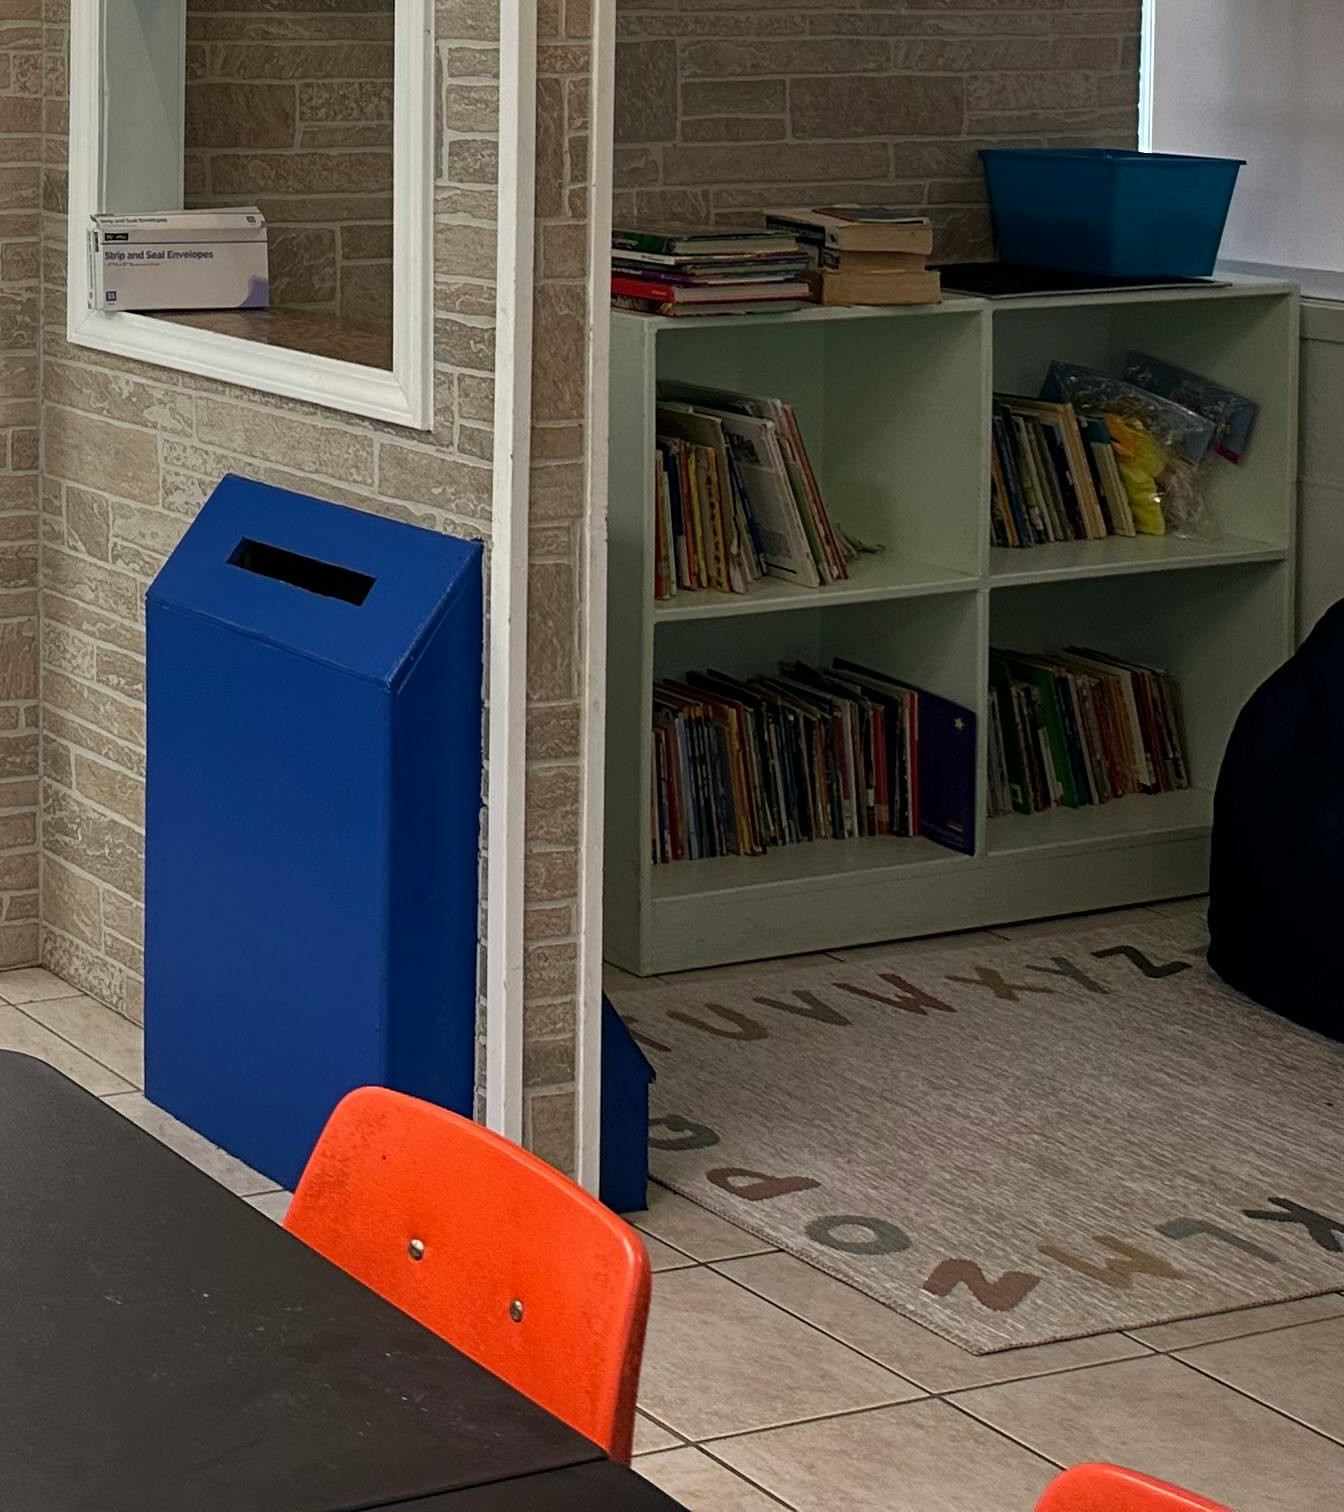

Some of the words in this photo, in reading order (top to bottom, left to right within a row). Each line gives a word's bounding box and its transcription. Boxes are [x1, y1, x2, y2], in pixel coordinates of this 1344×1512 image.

[104, 251, 125, 261] Strip
[127, 251, 144, 260] and
[146, 251, 165, 260] Seal
[167, 250, 214, 260] Envelopes
